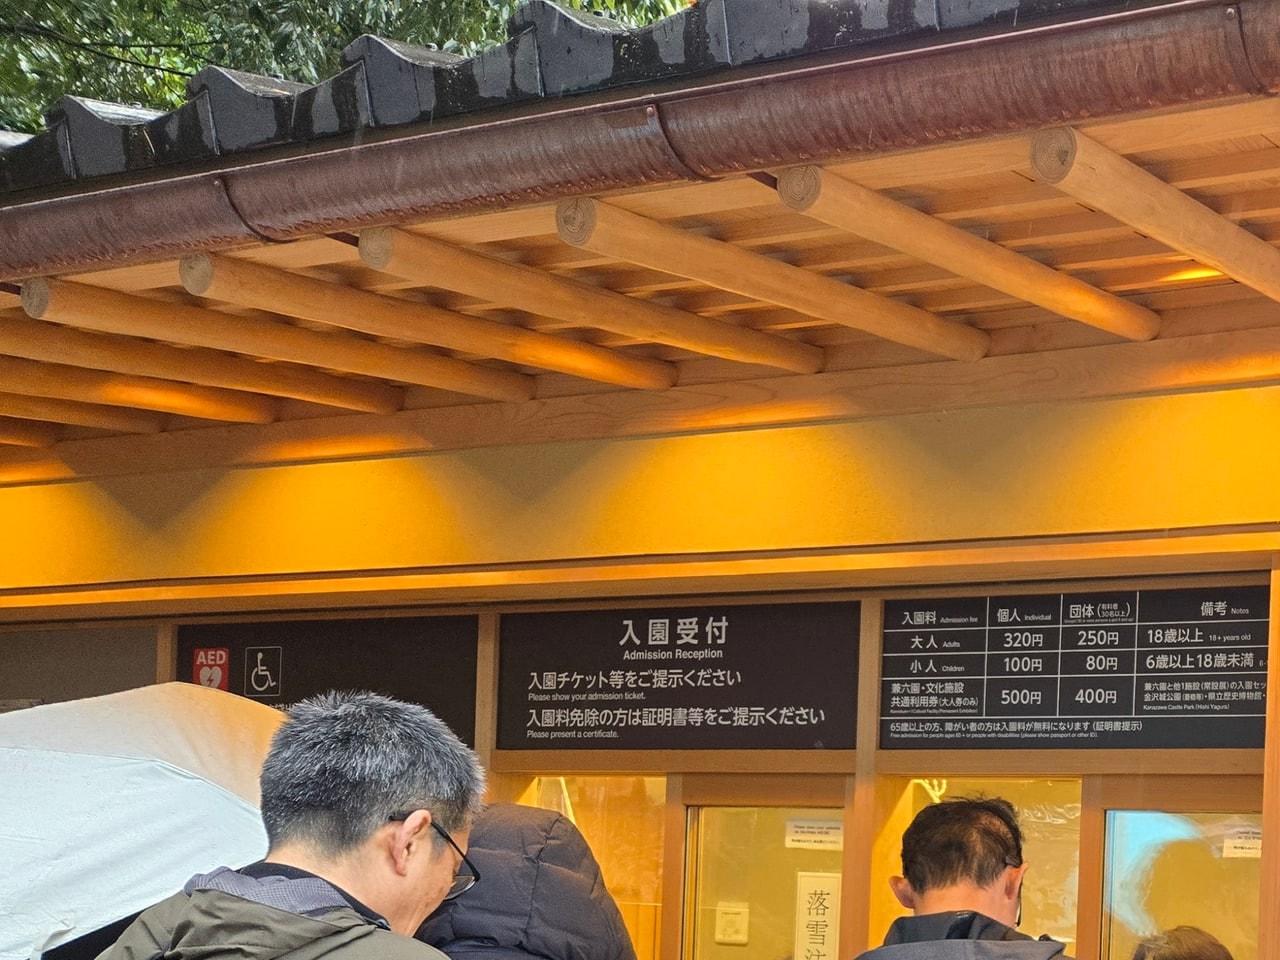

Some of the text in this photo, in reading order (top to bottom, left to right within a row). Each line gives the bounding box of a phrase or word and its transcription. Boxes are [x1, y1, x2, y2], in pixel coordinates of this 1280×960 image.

[997, 608, 1021, 622] 個人
[1070, 603, 1095, 618] 団体
[1201, 601, 1228, 616] 備考
[1231, 607, 1249, 615] Notes
[902, 611, 936, 625] 入園料
[619, 616, 728, 646] 入園受付
[1077, 630, 1119, 646] 250円
[1147, 628, 1204, 643] 18歳以上
[1223, 634, 1240, 642] years
[1241, 633, 1251, 641] old
[911, 635, 938, 649] 大人
[1003, 632, 1043, 648] 320円
[196, 651, 226, 665] AED
[623, 648, 723, 660] Admission Reception
[1146, 653, 1254, 669] 6歳以上18歳未満
[910, 659, 937, 673] 小人
[1004, 657, 1042, 672] 100円
[1086, 655, 1118, 671] 80円
[528, 669, 742, 690] 入園チケット等をご提示ください
[528, 691, 646, 702] Please show your admission ticket.
[1001, 689, 1041, 705] 500円
[1075, 689, 1117, 704] 400円
[526, 706, 825, 727] 入園料免除の方は証明書等をご提示ください
[527, 730, 549, 739] Please
[550, 730, 576, 739] present
[583, 729, 619, 738] certificate.
